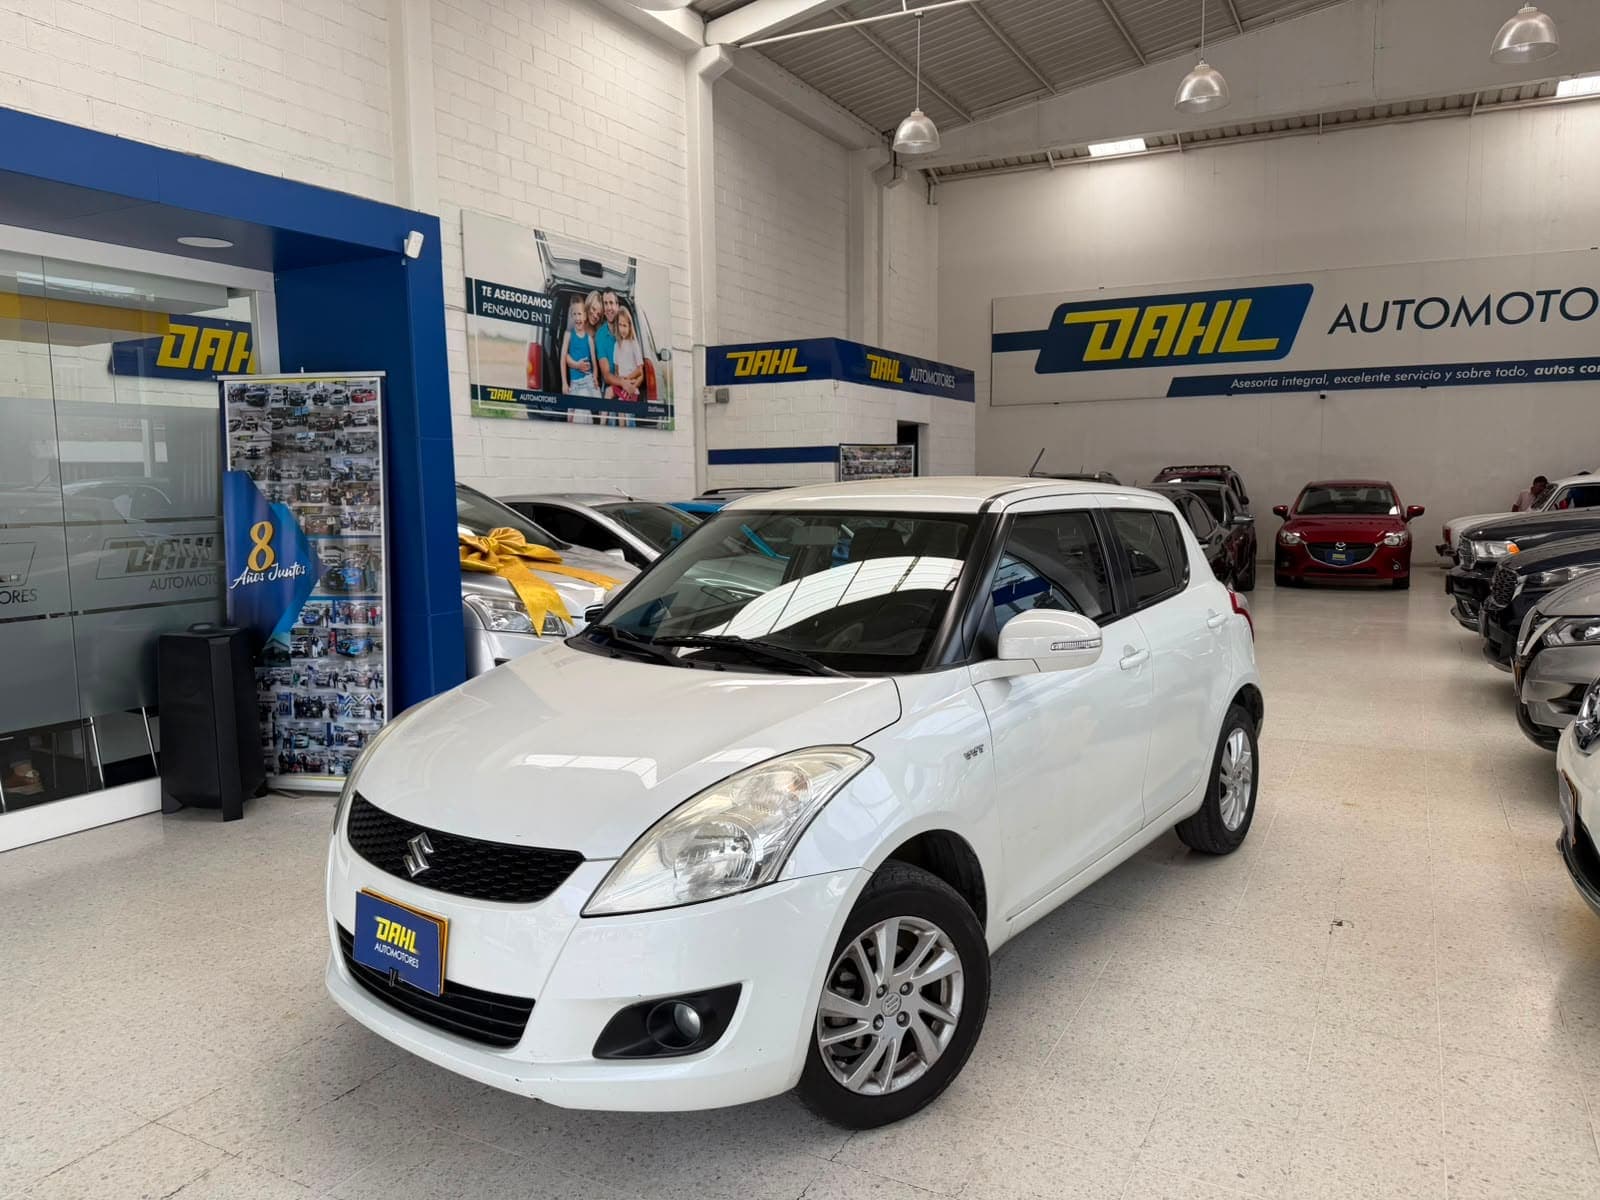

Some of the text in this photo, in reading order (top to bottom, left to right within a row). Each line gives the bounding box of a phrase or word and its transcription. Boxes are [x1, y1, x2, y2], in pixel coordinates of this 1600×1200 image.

[481, 285, 552, 310] TE ASESORAMOS
[482, 302, 529, 320] PENSANDO
[531, 311, 542, 323] EN
[1064, 286, 1600, 362] DAHL AUTOMOTO
[726, 348, 808, 376] DAHL
[866, 353, 956, 389] DAHL AUTOMOTORES
[1230, 364, 1600, 388] Asesoría integral, excelente servicio y sobre todo, autos co
[486, 388, 557, 404] DAHL AUTOMOTORES
[247, 520, 275, 572] 8
[229, 561, 306, 590] Años Juntos
[374, 915, 421, 956] DAHL
[373, 942, 419, 969] AUTOMOTORES
